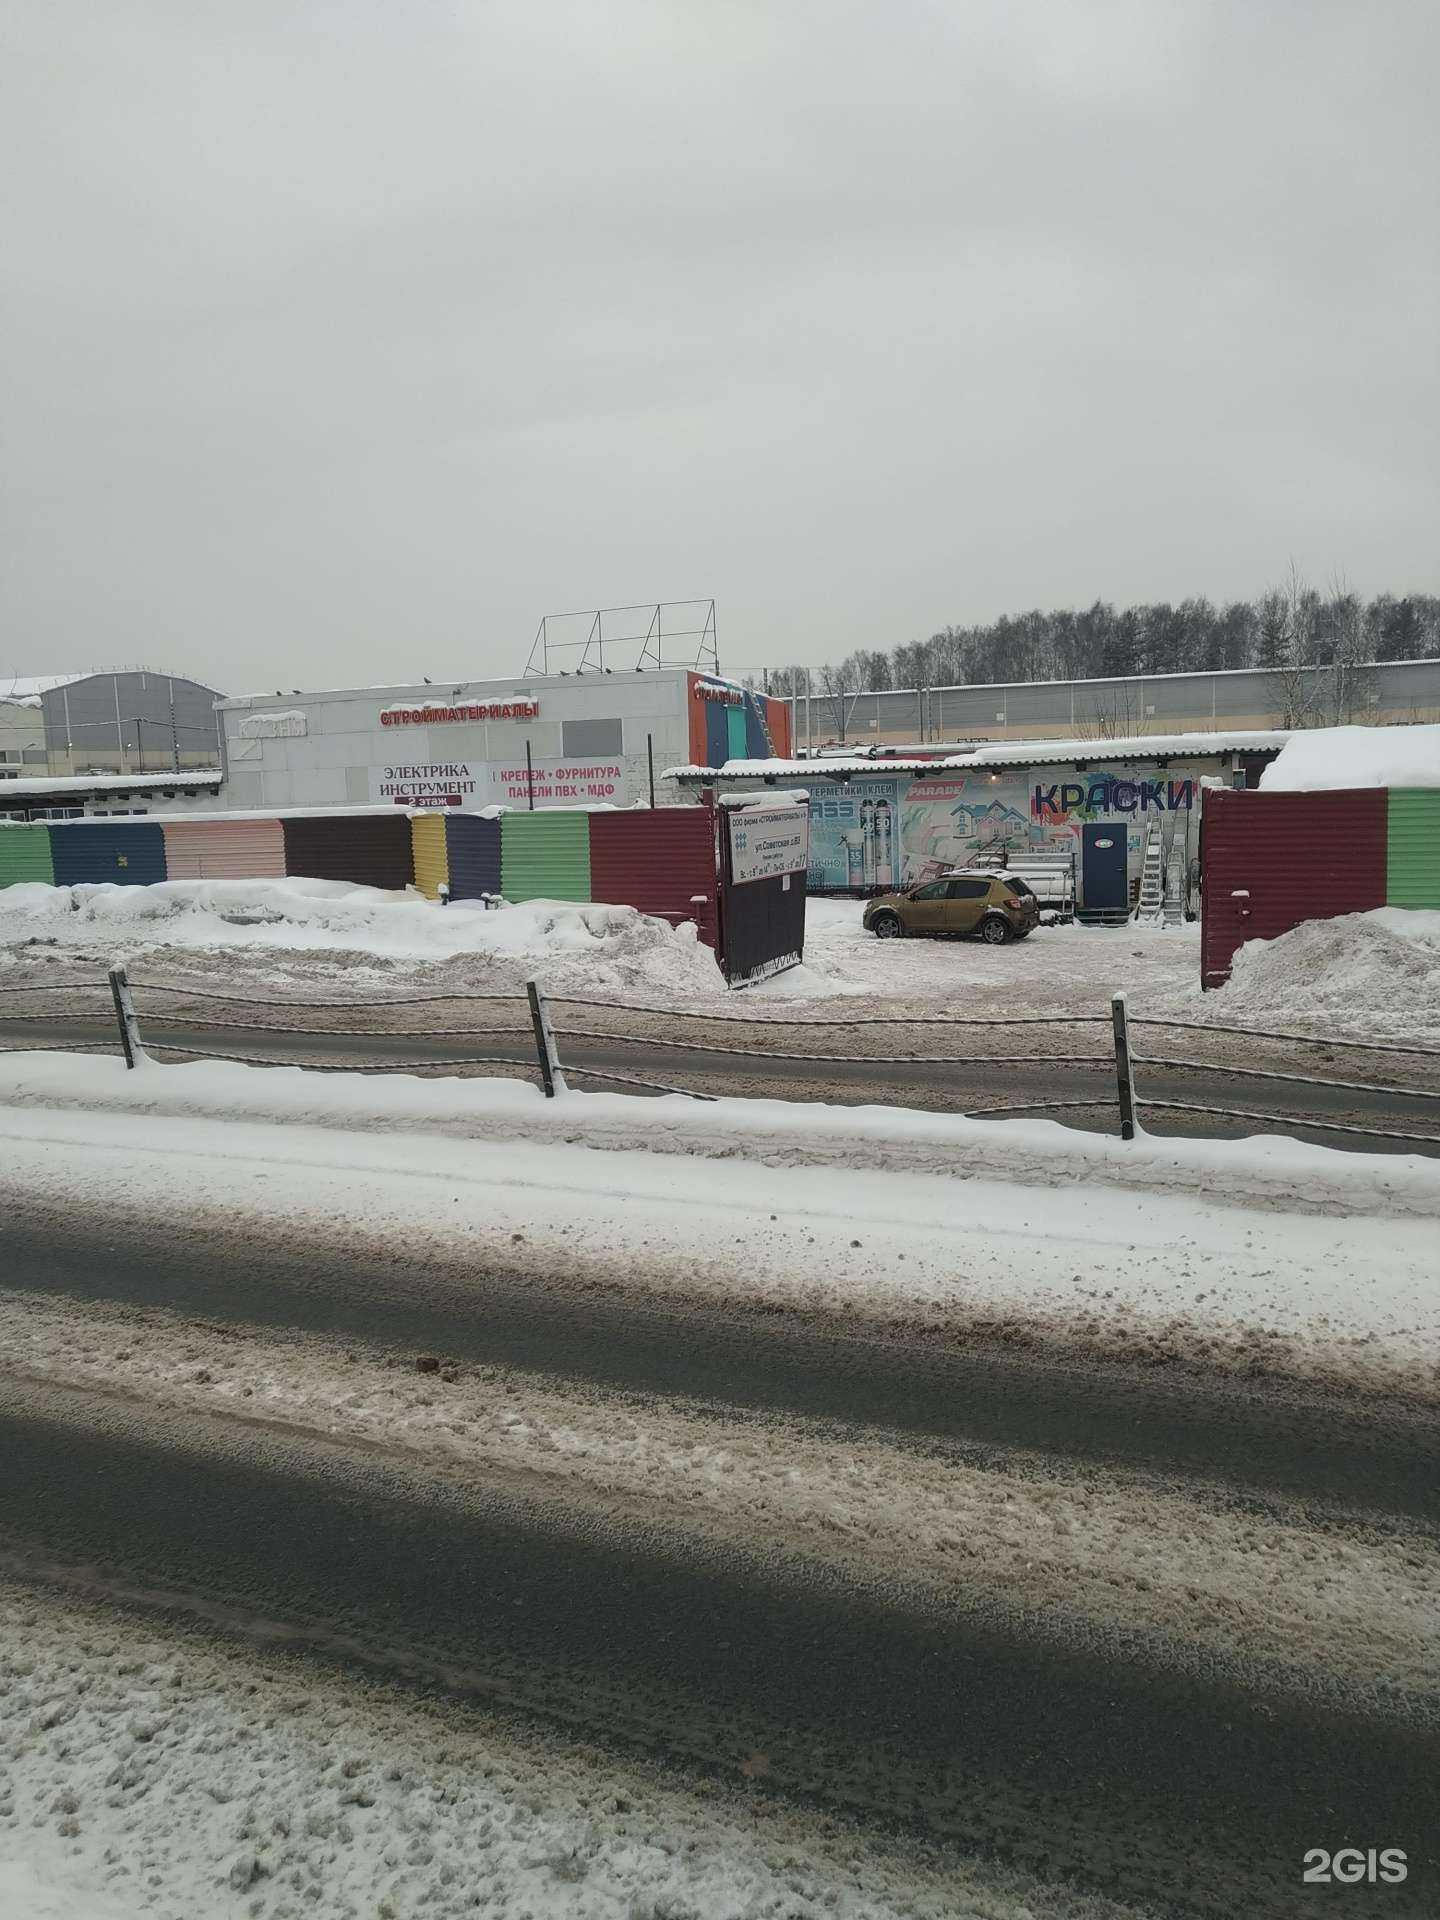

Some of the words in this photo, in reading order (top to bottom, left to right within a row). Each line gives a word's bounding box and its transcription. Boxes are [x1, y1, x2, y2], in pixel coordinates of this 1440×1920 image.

[380, 702, 539, 726] СТРОЙМАТЕРИАЛЫ
[384, 764, 470, 779] ЭЛЕКТРИКА
[501, 769, 545, 782] КРЕПЕЖ
[555, 766, 621, 779] ФУРНИТУРА
[380, 781, 476, 796] ИНСТРУМЕНТ
[508, 786, 553, 798] ПАНЕЛИ
[555, 785, 577, 797] ПВХ
[587, 784, 615, 797] МДФ
[810, 785, 862, 797] ГЕРМЕТИКИ
[908, 785, 961, 797] PARADE
[408, 798, 416, 806] 2
[419, 797, 447, 806] этаж
[1035, 779, 1193, 814] КРАСКИ
